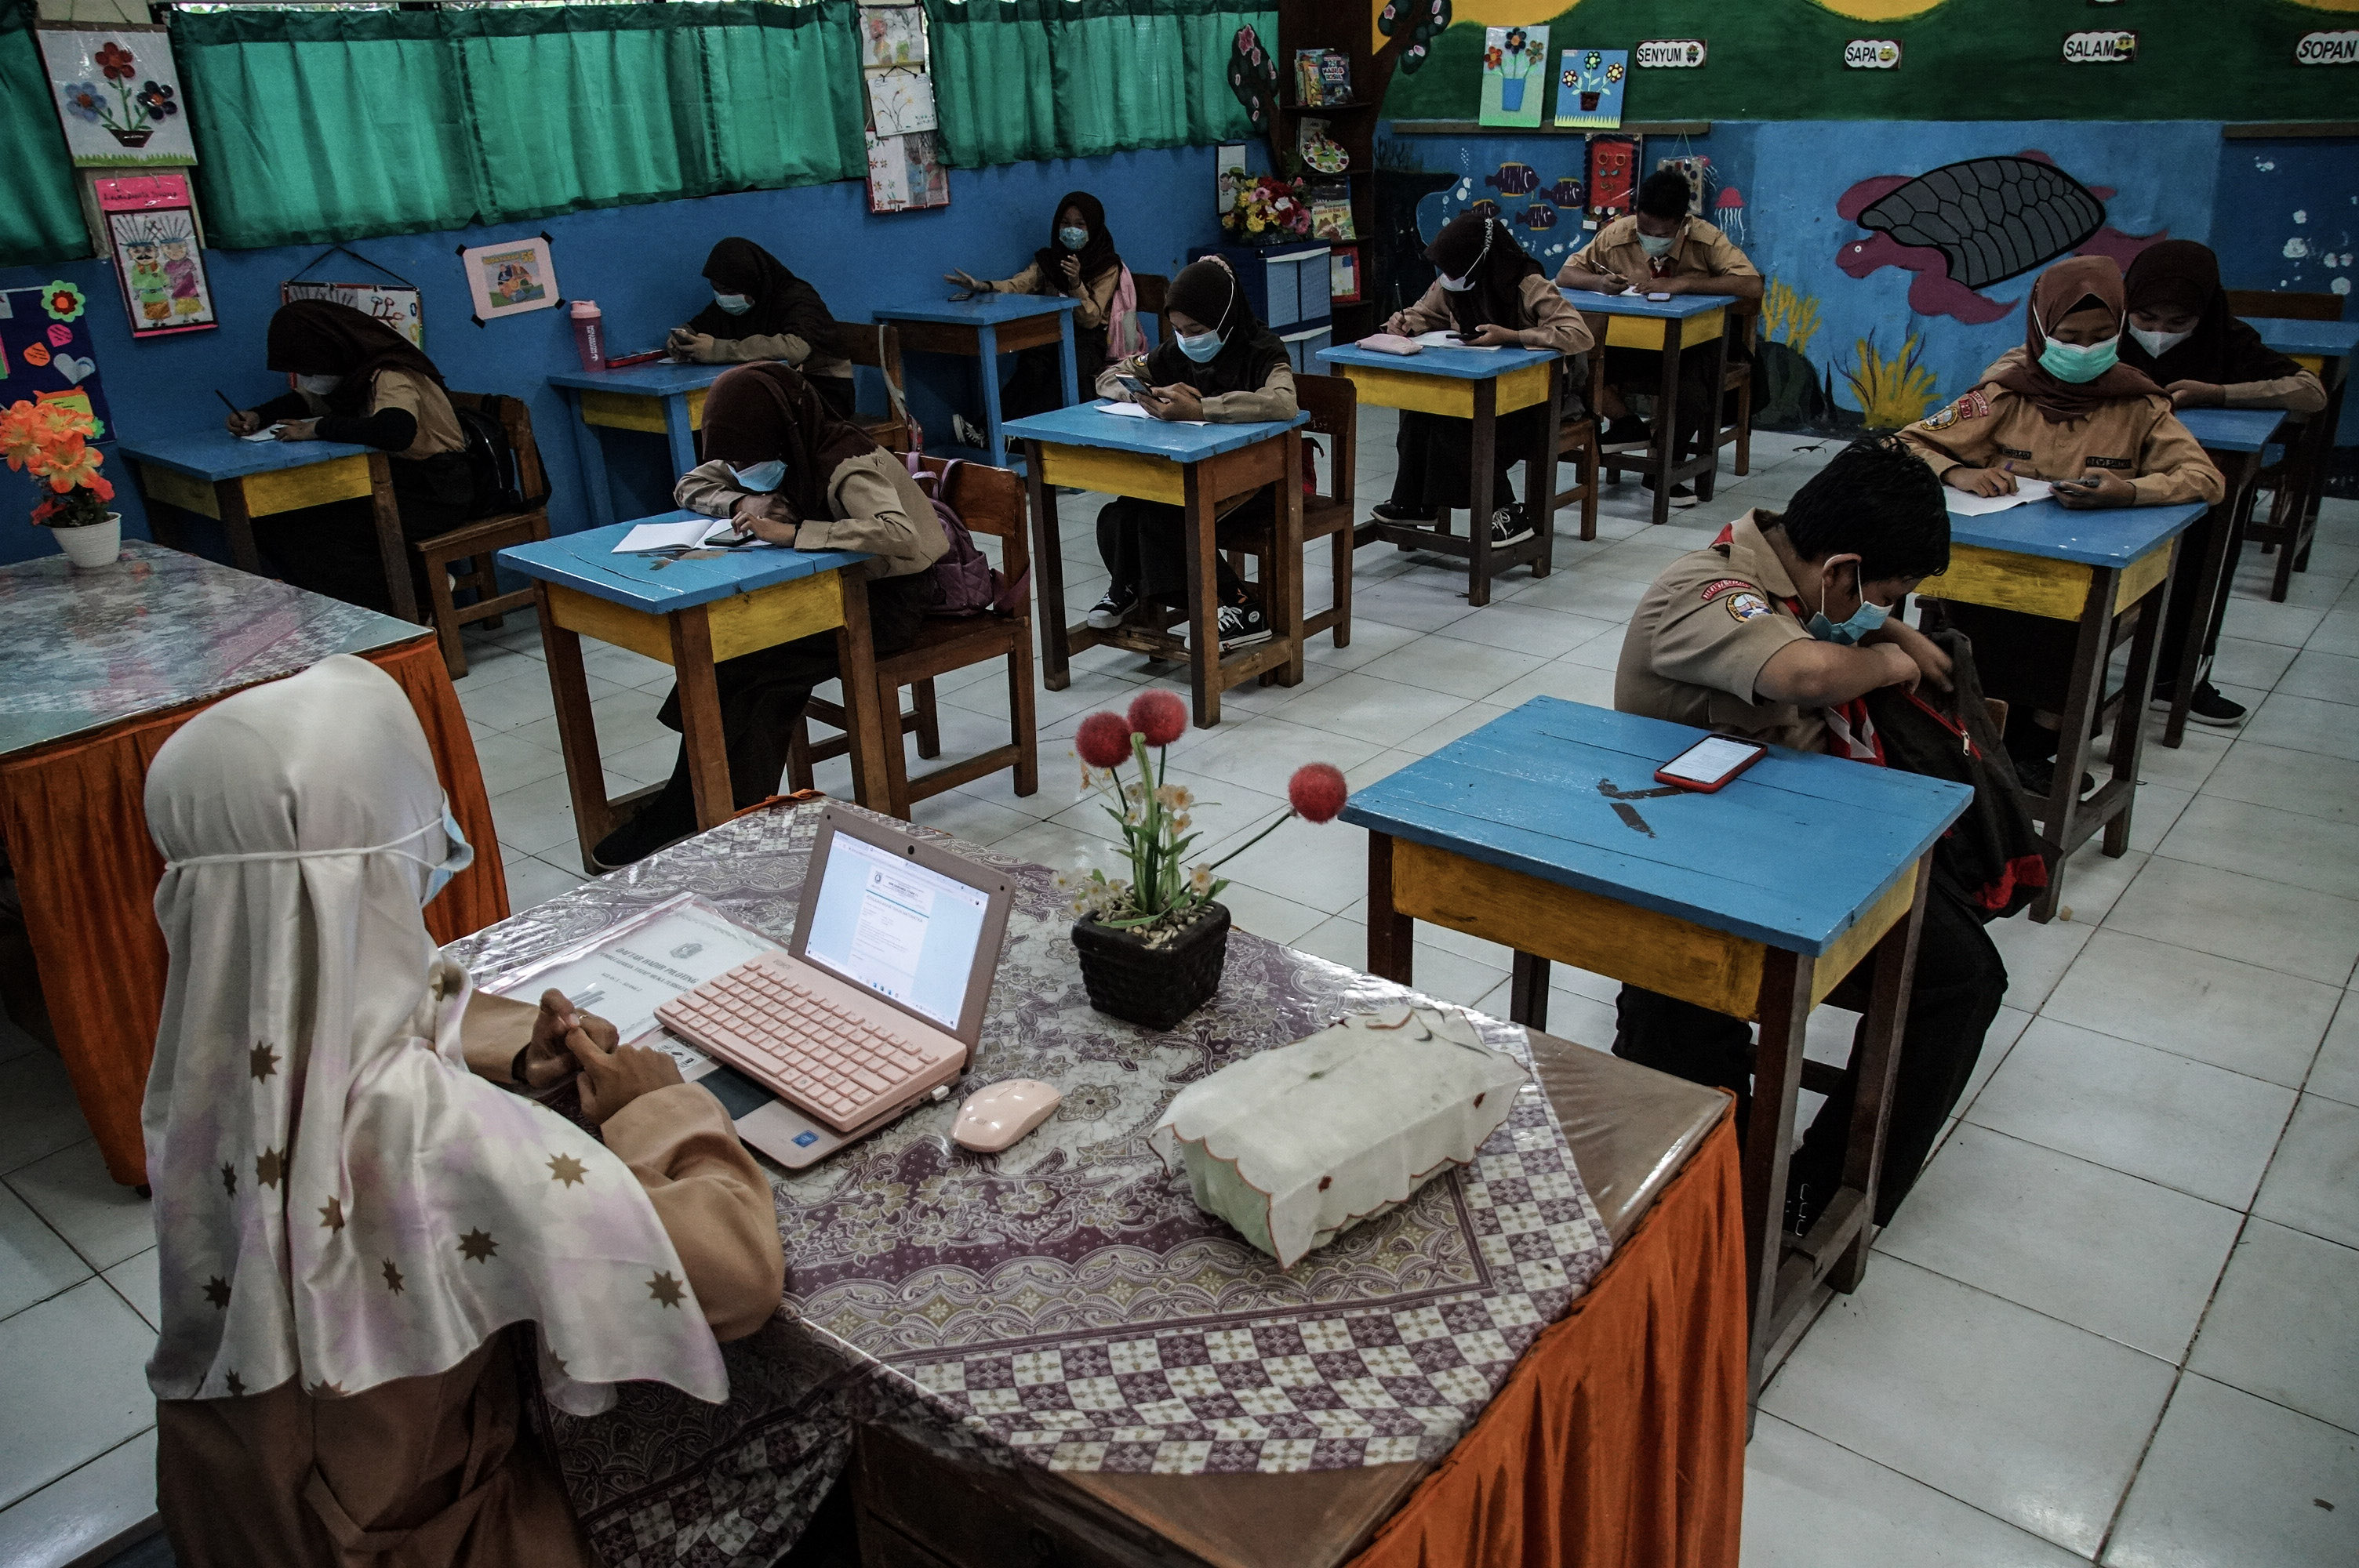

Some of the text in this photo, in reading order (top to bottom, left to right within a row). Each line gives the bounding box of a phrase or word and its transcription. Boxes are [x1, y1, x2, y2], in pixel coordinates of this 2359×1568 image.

[1637, 48, 1681, 62] SENYUM
[1846, 47, 1877, 62] SAPA
[2065, 40, 2115, 56] SALAM
[2299, 40, 2357, 59] SOPAN
[615, 947, 699, 984] DAFTAR HADIR PILOTING
